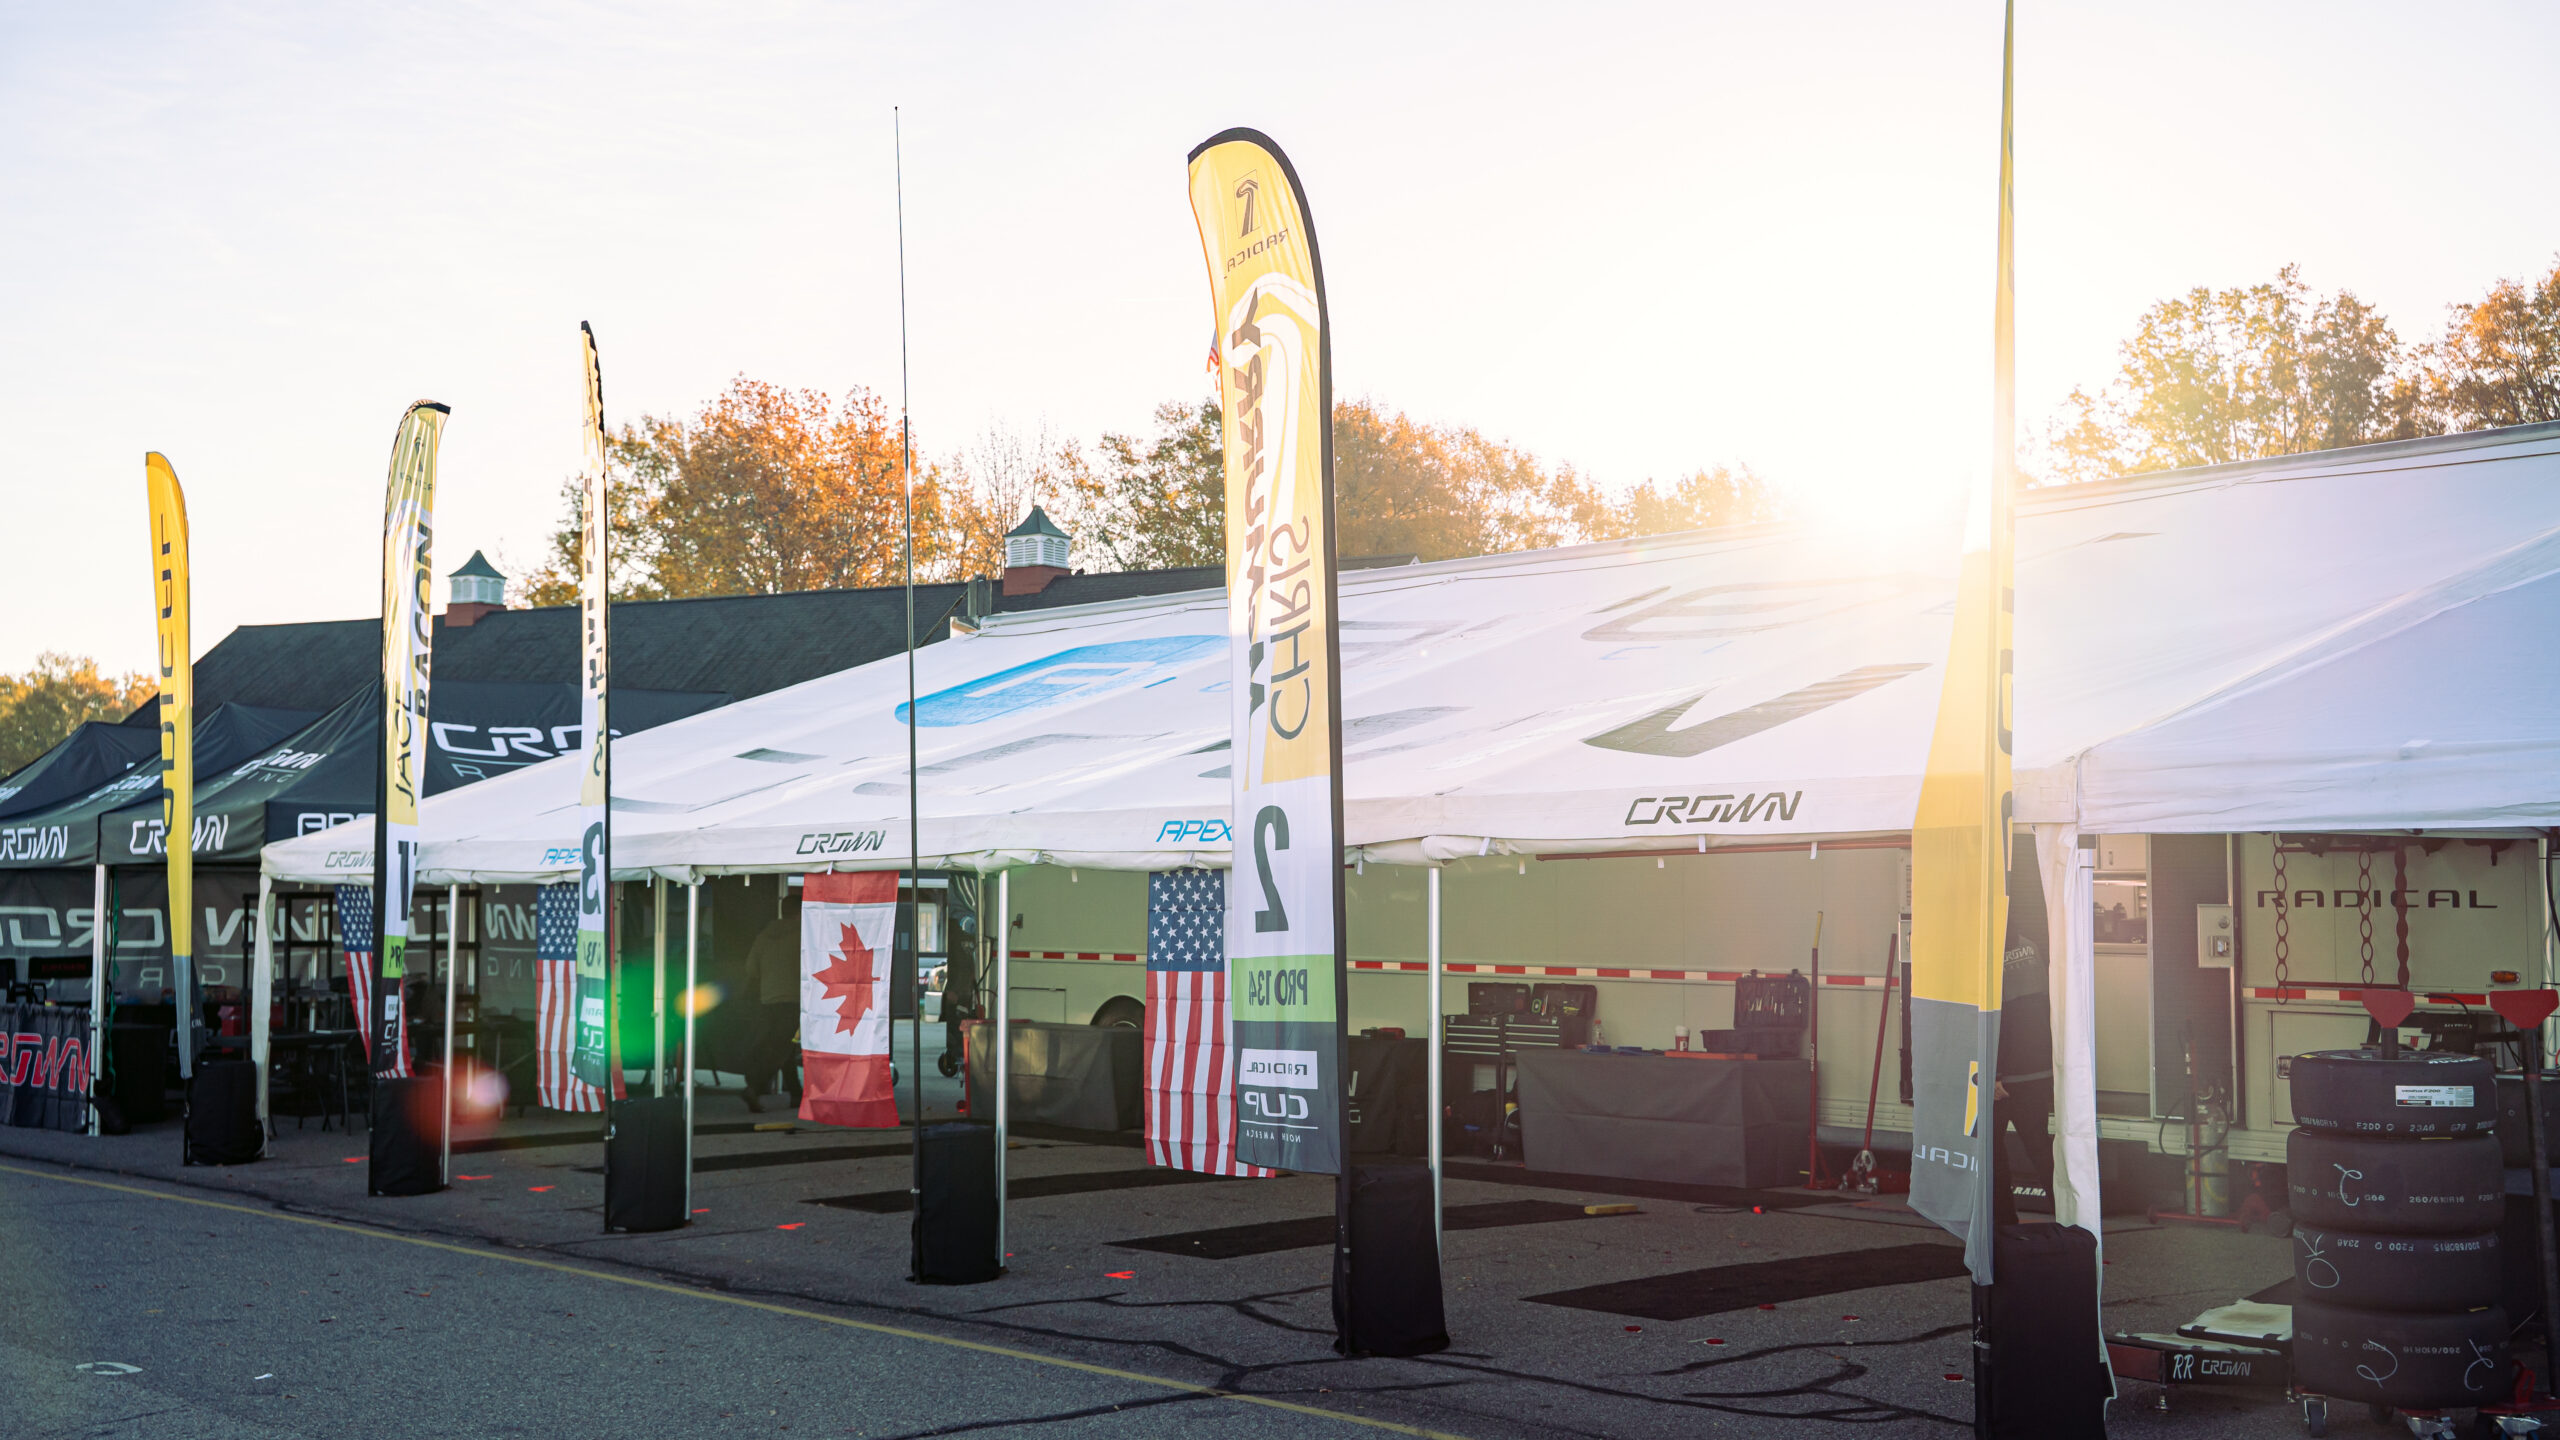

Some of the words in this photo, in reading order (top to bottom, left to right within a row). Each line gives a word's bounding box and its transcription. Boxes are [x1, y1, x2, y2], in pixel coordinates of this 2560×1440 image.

[431, 722, 622, 757] CRO
[1624, 790, 1803, 825] CROWN
[0, 825, 68, 861] ROWN
[130, 814, 228, 855] CRWN
[796, 830, 887, 855] CROWN
[1156, 819, 1233, 843] APEX
[539, 848, 582, 865] APE
[2257, 890, 2498, 909] RADICAL
[2173, 1353, 2195, 1380] RR
[2201, 1359, 2251, 1377] CROWN
